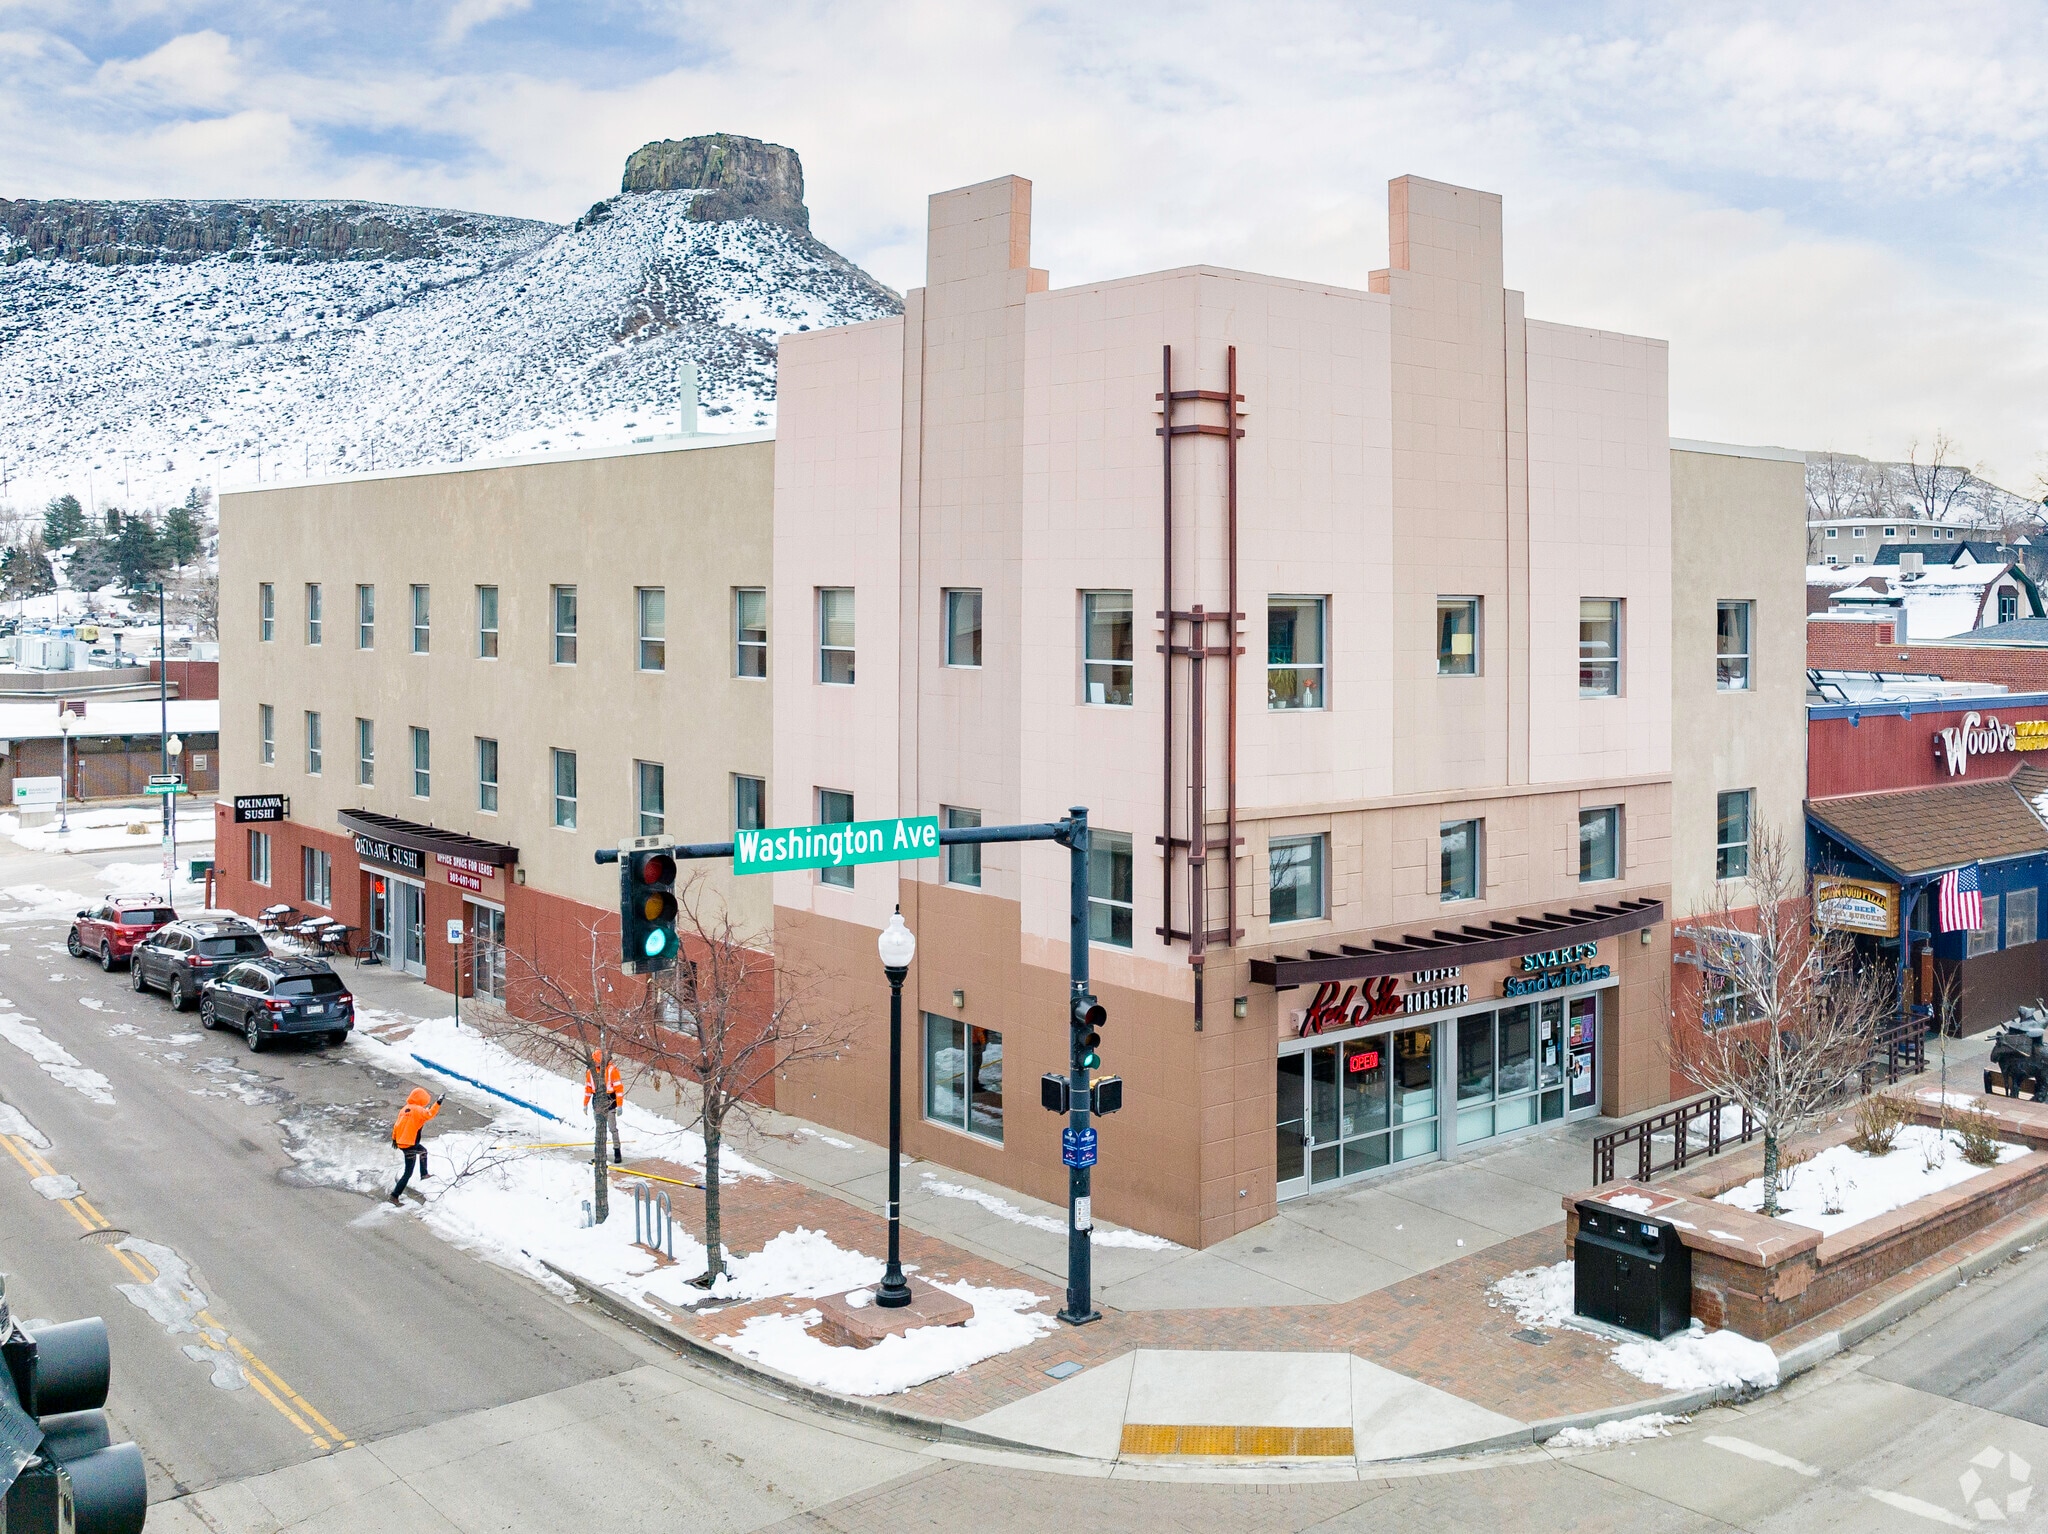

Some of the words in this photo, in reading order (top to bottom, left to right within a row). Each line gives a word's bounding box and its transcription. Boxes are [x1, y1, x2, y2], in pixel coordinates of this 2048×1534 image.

[237, 797, 282, 809] OKINAWA
[244, 808, 275, 820] SUSHI
[355, 838, 390, 861] OKINAWA
[392, 852, 418, 869] SUSHI
[738, 824, 883, 865] Washington
[893, 819, 936, 850] Ave
[453, 856, 468, 870] SPACE
[468, 859, 478, 873] FOR
[478, 862, 493, 877] LEASE
[1849, 911, 1887, 923] BURGERS
[1854, 904, 1877, 914] BEER
[1523, 941, 1598, 972] SNARF'S
[1504, 964, 1611, 998] Sandwiches
[1300, 981, 1358, 1038] Red
[1406, 984, 1469, 1014] ROASTERS
[1352, 1053, 1377, 1070] OPEN
